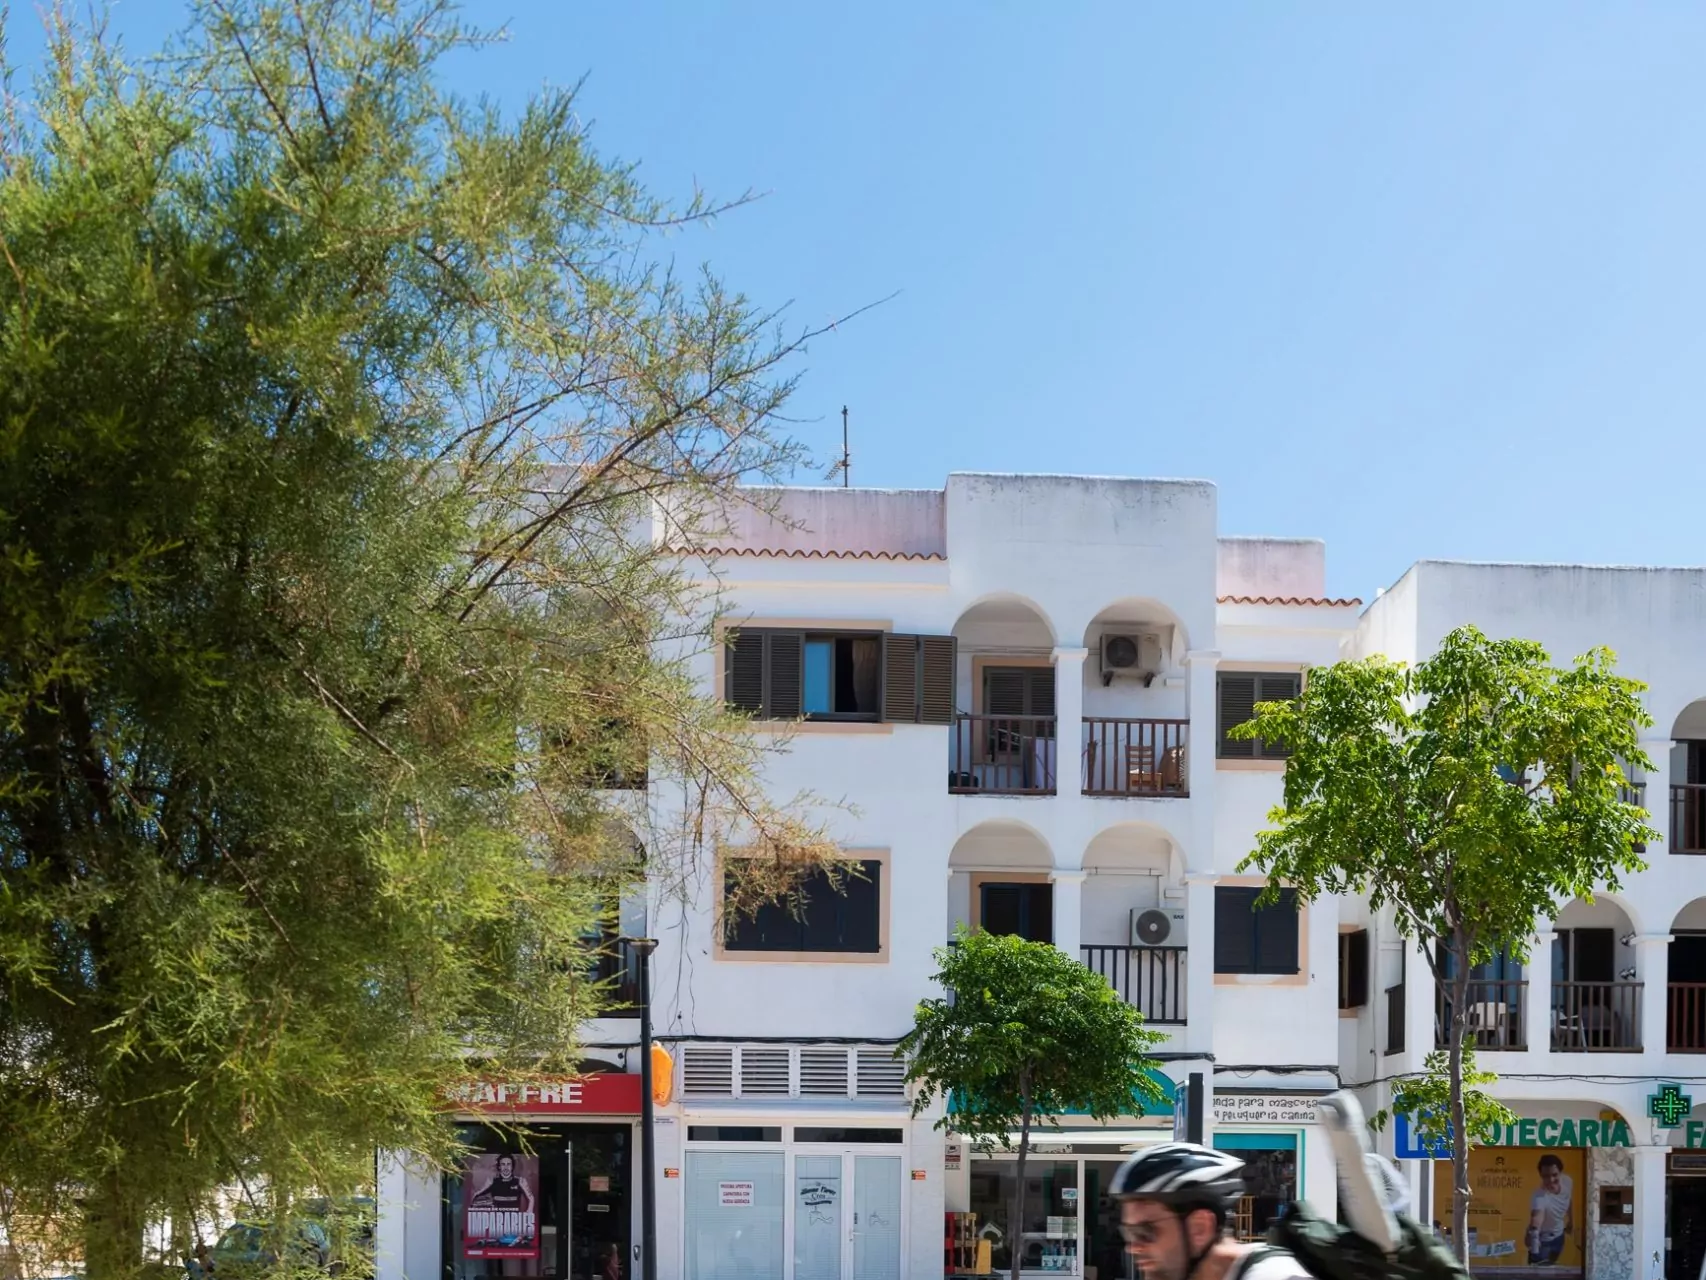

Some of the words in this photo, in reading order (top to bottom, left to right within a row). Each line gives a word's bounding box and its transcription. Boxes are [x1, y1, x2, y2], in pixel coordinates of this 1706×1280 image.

[1239, 1099, 1264, 1109] para
[1269, 1099, 1318, 1108] mascota
[1281, 1111, 1315, 1120] canina
[1481, 1118, 1630, 1147] OTECARIA
